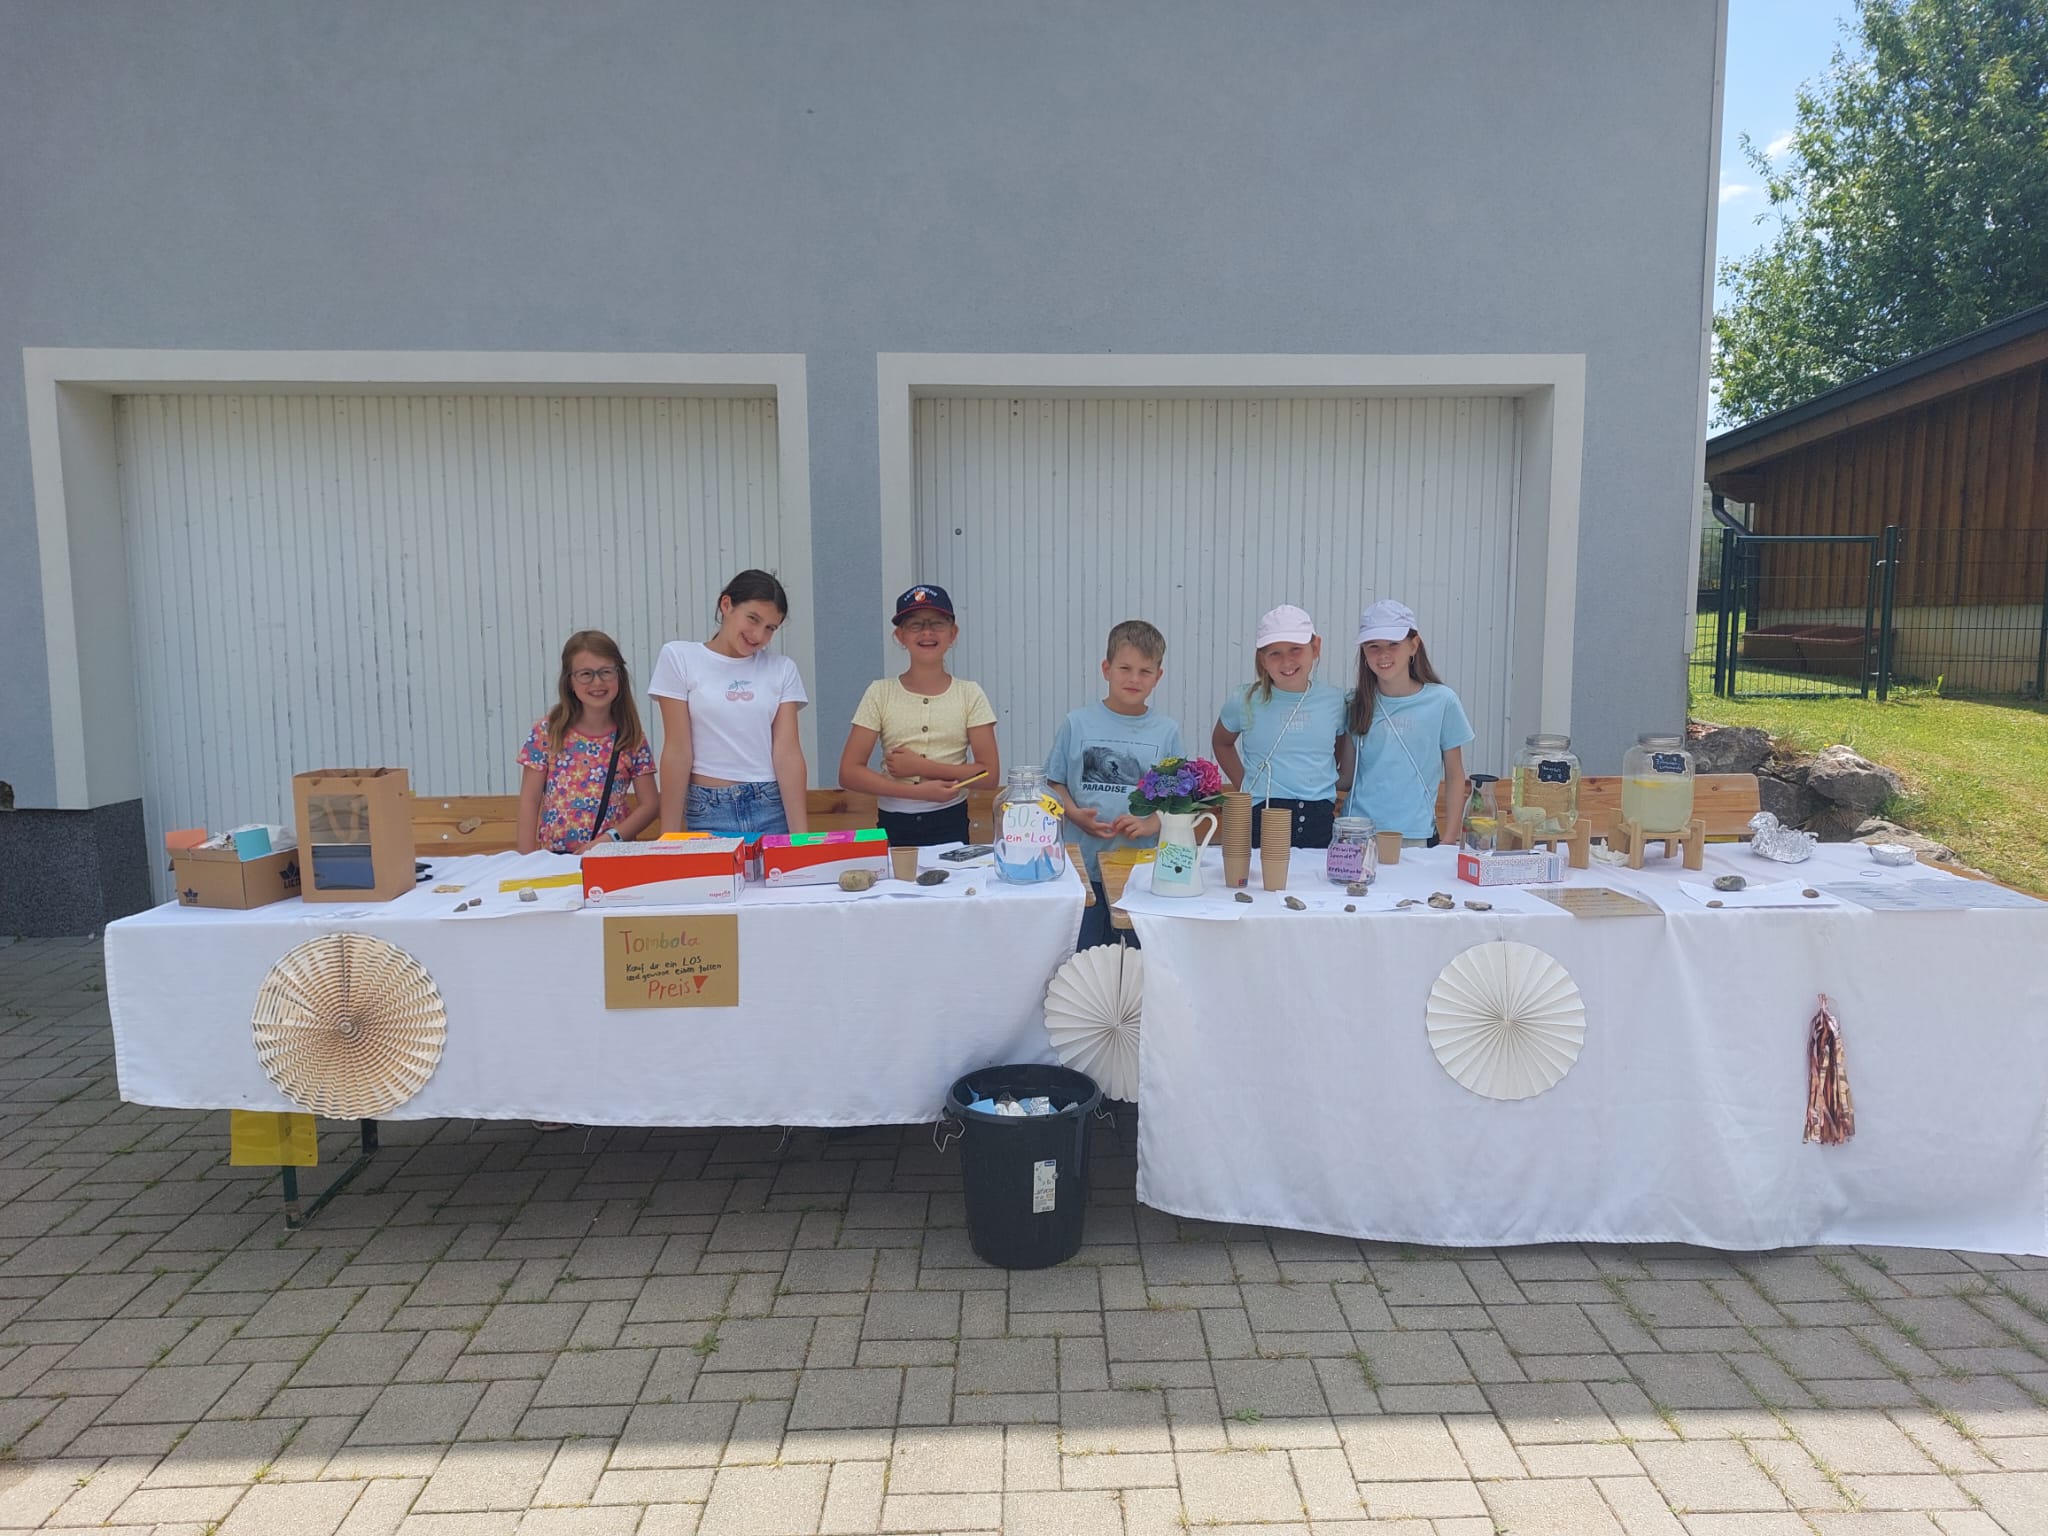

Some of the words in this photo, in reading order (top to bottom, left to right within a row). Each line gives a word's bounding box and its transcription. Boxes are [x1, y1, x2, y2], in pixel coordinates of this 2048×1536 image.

[1082, 783, 1128, 793] PARADISE
[1047, 800, 1058, 815] 12
[1006, 834, 1022, 842] ein
[1030, 832, 1052, 843] Los
[618, 930, 699, 954] Tombola
[626, 963, 645, 973] Kauf
[665, 960, 678, 968] ein
[626, 974, 641, 982] und
[699, 963, 722, 974] tollen
[647, 975, 709, 1000] Preis!
